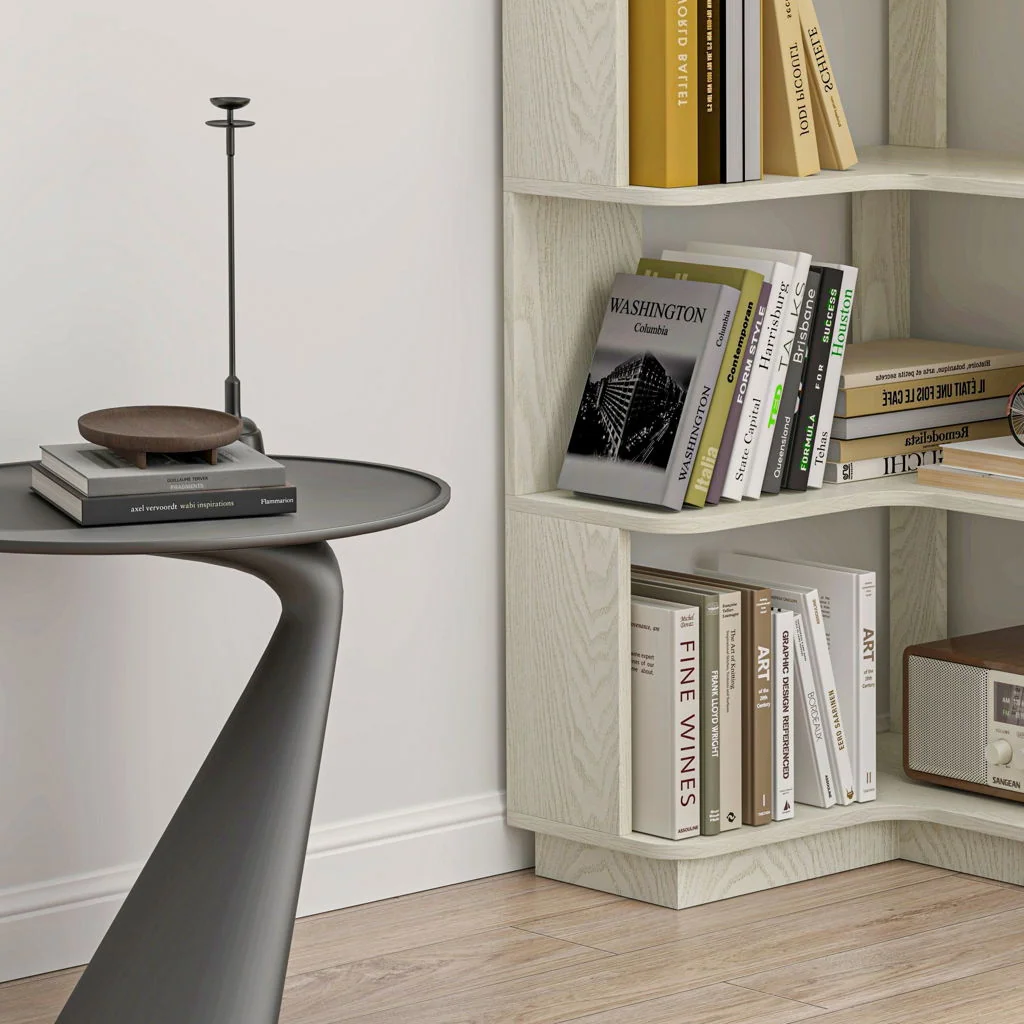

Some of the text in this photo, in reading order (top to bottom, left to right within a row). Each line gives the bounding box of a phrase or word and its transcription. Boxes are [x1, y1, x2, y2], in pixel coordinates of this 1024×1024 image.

[610, 297, 707, 324] WASHINGTON
[634, 323, 668, 336] Columbia
[759, 282, 789, 370] Harrisburg
[793, 288, 815, 364] Brisbane
[831, 288, 853, 357] Houston
[737, 306, 766, 404] FORM STYLE
[800, 288, 837, 472] FORMULA FOR SUCCESS
[678, 310, 730, 481] WASHINGTON Columbia
[695, 447, 718, 493] Italia
[736, 398, 761, 482] State Capital
[774, 416, 790, 478] Queensland
[146, 502, 177, 511] vervoordt
[198, 501, 234, 509] inspirations
[757, 646, 770, 681] ART
[680, 640, 695, 806] FINE WINES
[993, 777, 1020, 788] SANGEAN
